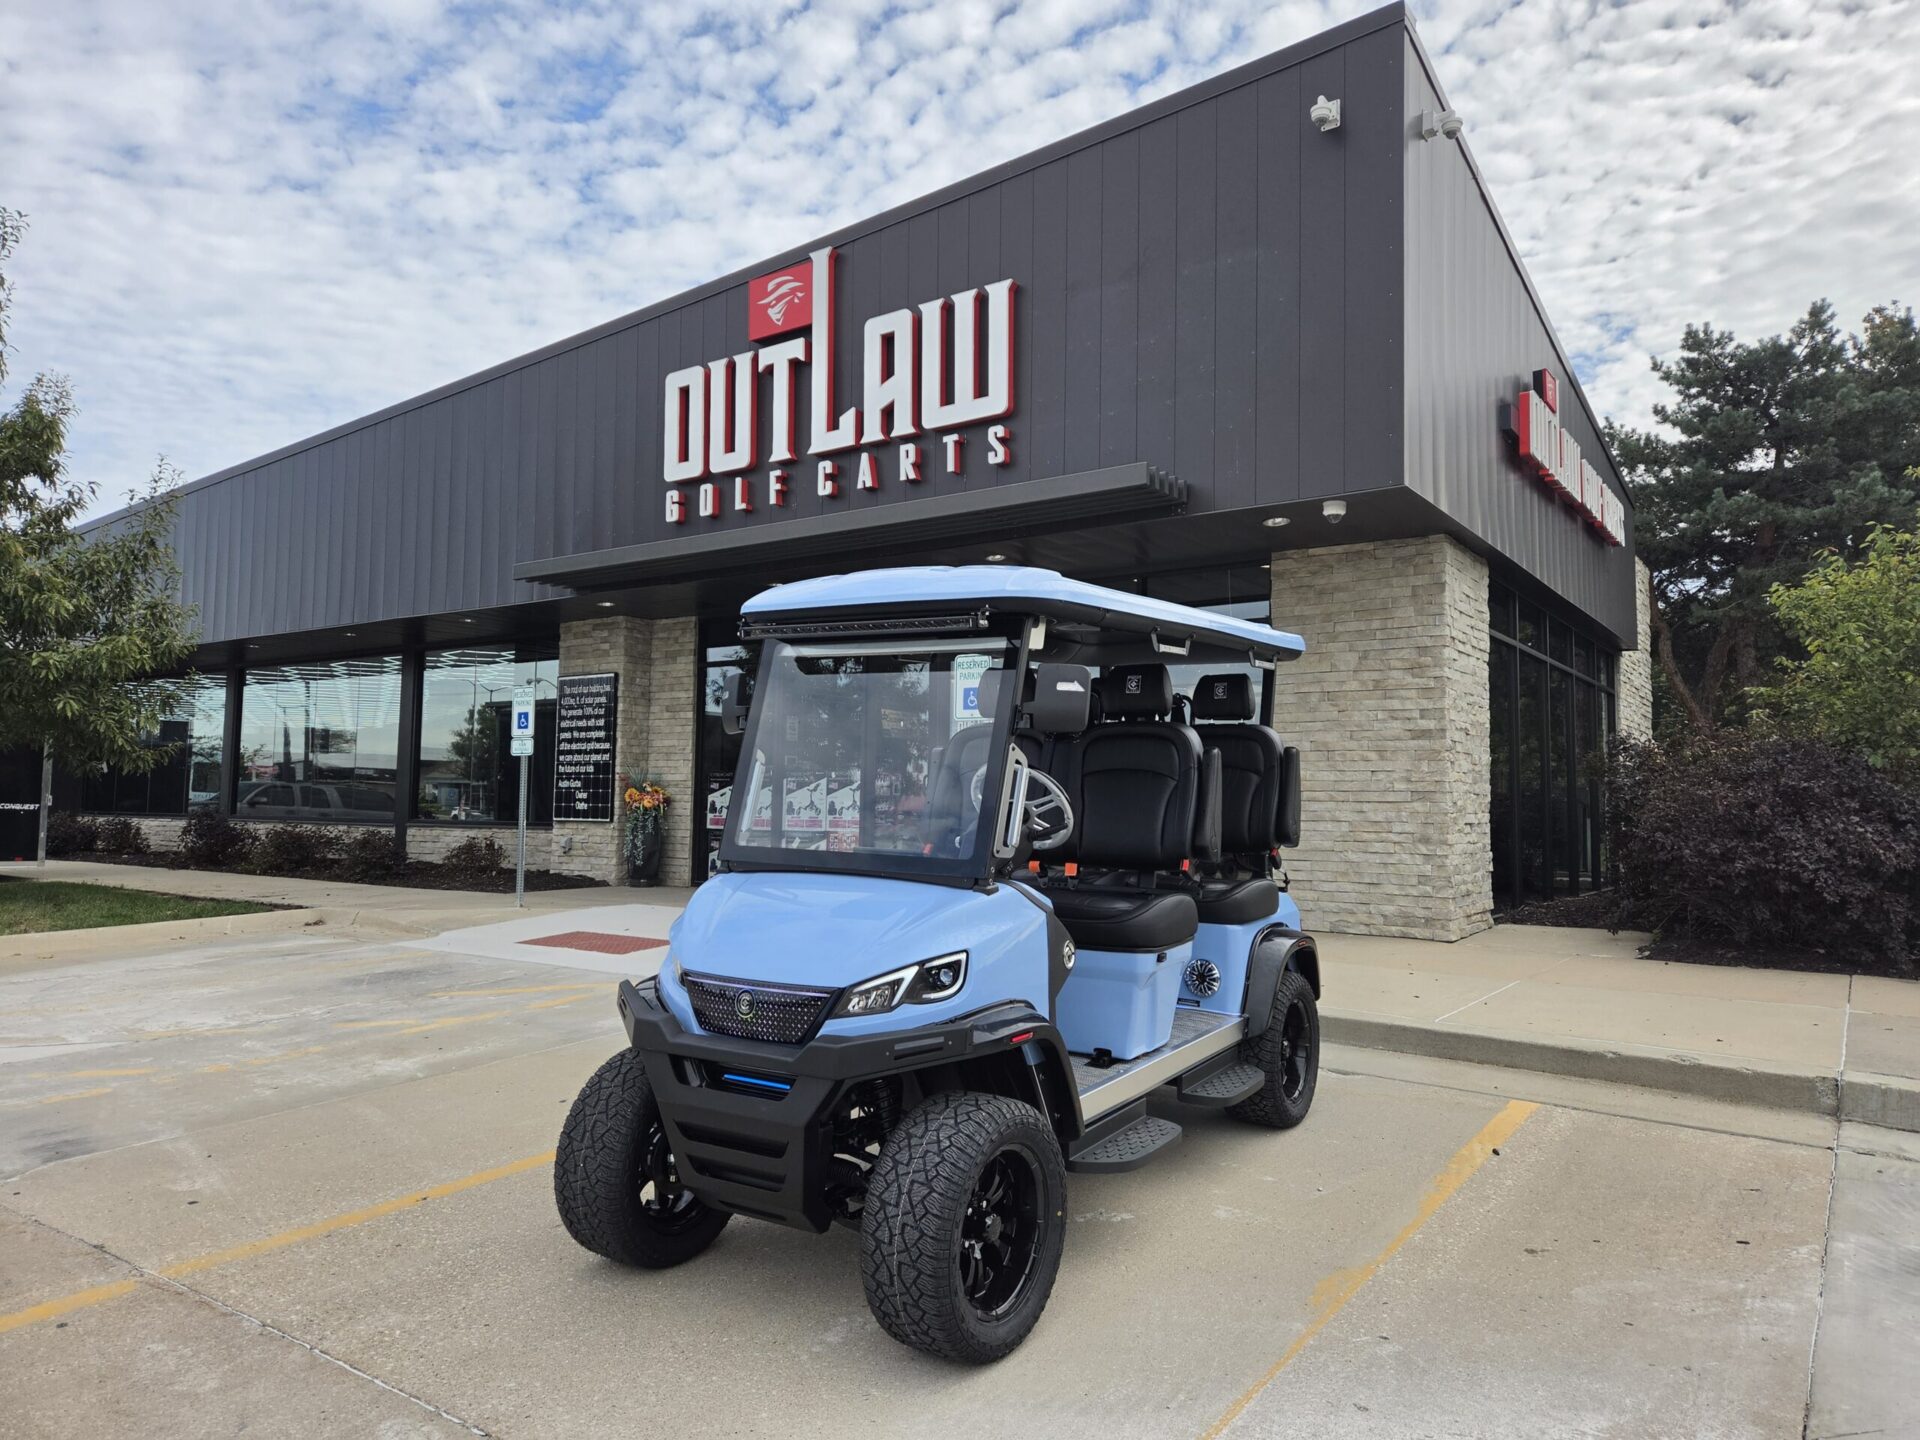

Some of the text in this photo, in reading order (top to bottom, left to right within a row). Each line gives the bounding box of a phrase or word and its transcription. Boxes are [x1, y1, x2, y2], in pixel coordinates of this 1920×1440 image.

[664, 246, 1016, 482] OUTLAW
[666, 424, 1010, 523] GOLF CARTS
[958, 661, 988, 669] RESERVED
[960, 671, 982, 680] PARKIN
[575, 790, 588, 799] Owner
[0, 802, 40, 810] CONQUEST
